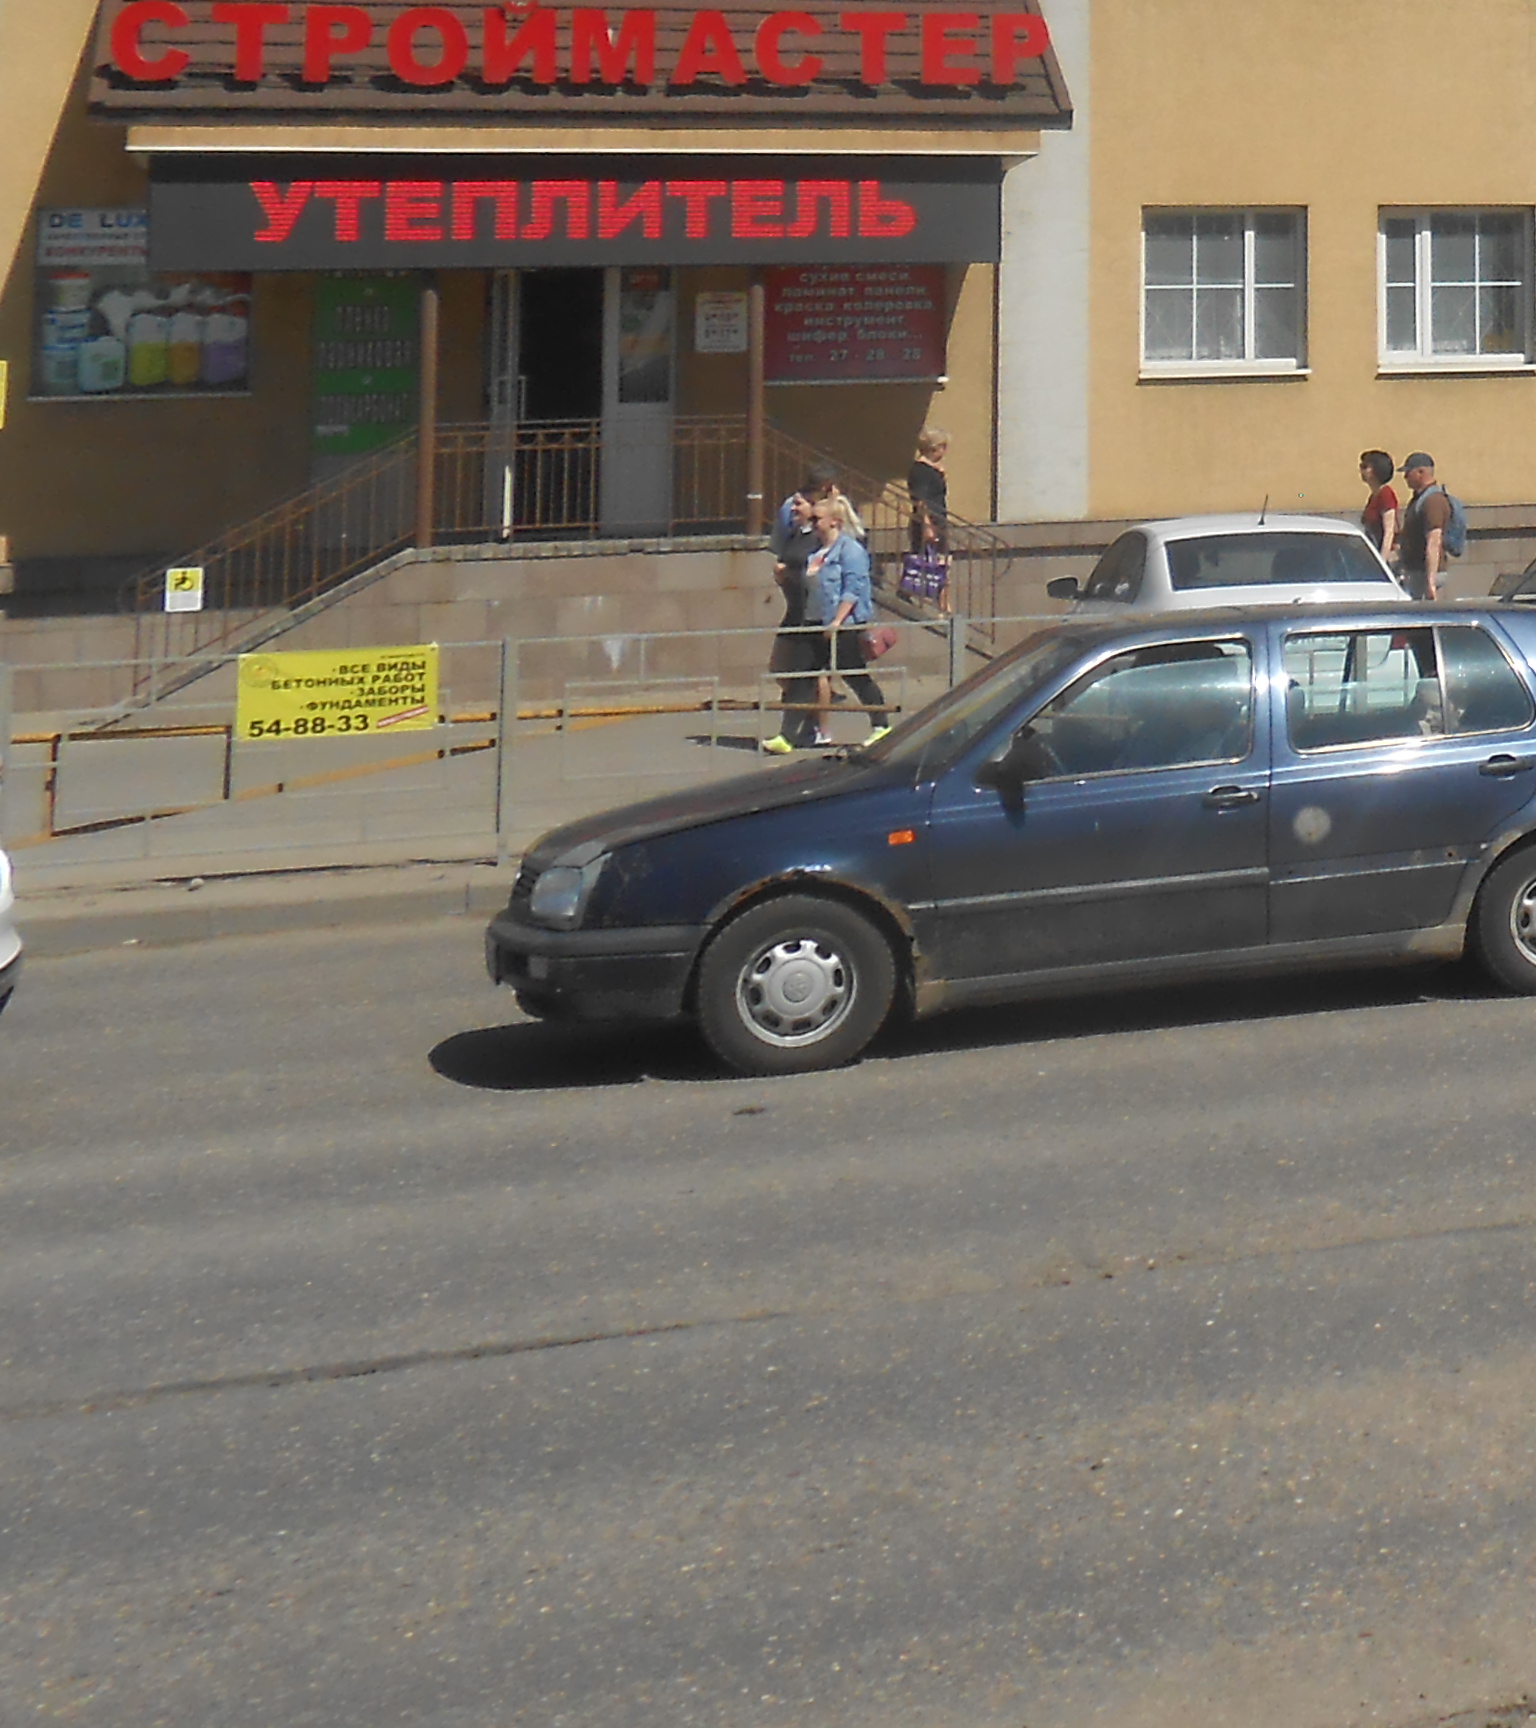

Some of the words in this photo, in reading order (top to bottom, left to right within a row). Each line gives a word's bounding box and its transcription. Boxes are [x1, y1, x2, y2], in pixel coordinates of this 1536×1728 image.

[110, 0, 1050, 86] СТРОЙМАСТЕР
[250, 178, 918, 243] УТЕПЛИТЕЛЬ
[339, 663, 371, 675] ВСЕ
[376, 660, 426, 673] ВИДЫ
[271, 676, 365, 691] БЕТОННЫХ
[371, 672, 426, 685] РАБОТ
[356, 684, 426, 698] ЗАБОРЫ
[306, 696, 425, 710] ФУНДАМЕНТЫ
[249, 713, 370, 738] 54-88-33
